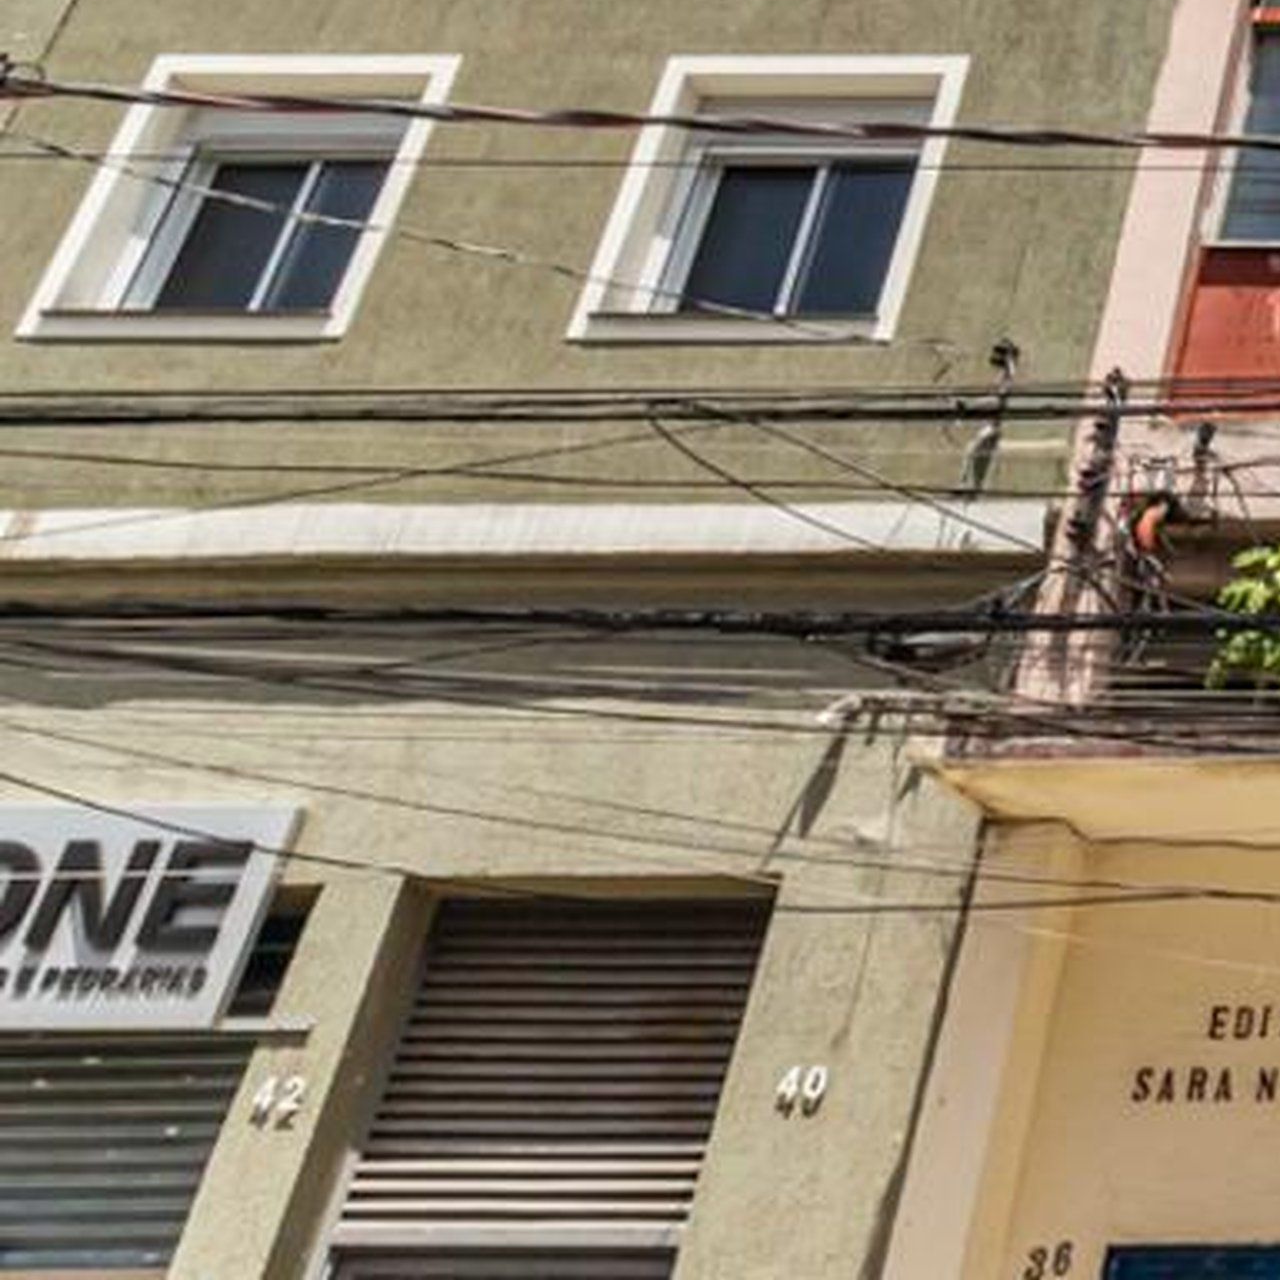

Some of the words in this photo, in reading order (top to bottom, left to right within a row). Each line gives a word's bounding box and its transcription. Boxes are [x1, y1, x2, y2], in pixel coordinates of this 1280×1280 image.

[252, 1075, 305, 1111] 42
[775, 1064, 828, 1101] 40
[1131, 1065, 1233, 1104] SARA
[1023, 1239, 1074, 1280] 36
